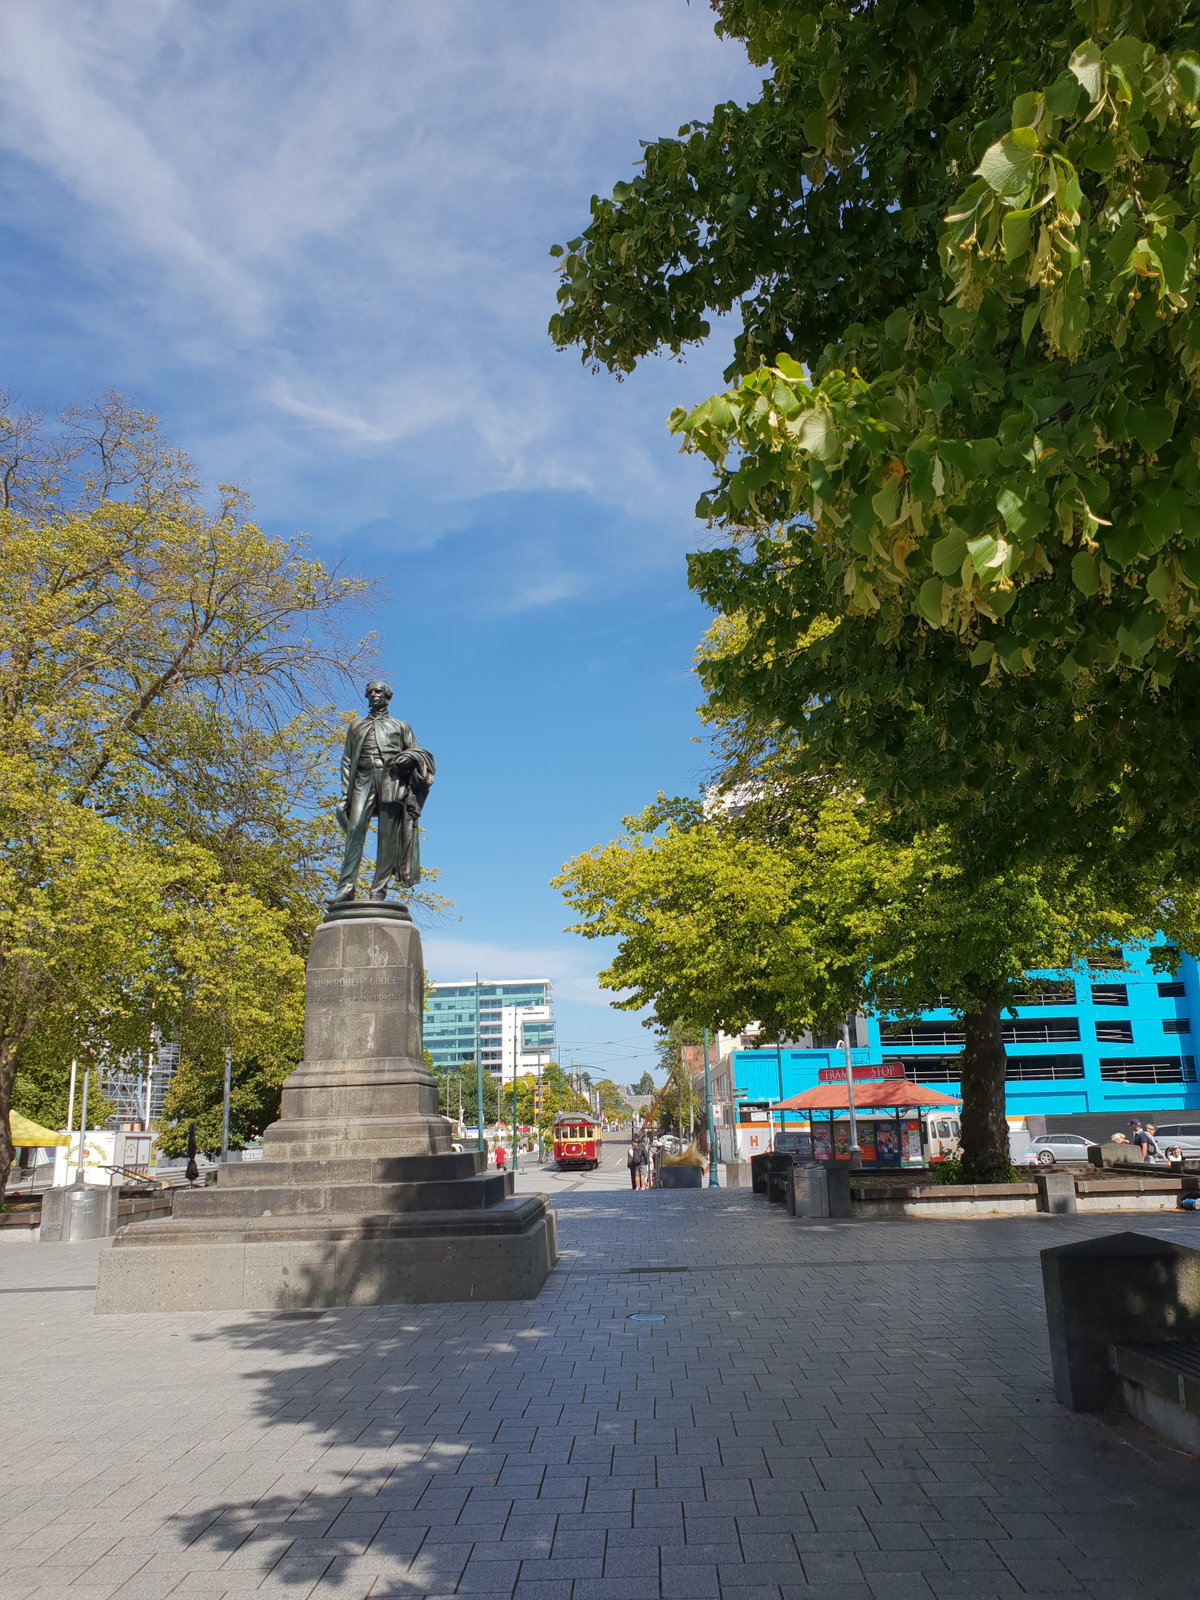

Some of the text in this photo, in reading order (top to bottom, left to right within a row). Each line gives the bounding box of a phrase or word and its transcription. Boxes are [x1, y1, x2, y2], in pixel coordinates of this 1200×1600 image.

[334, 977, 368, 987] ROBERT
[871, 1066, 895, 1078] STOP
[749, 1135, 759, 1147] H
